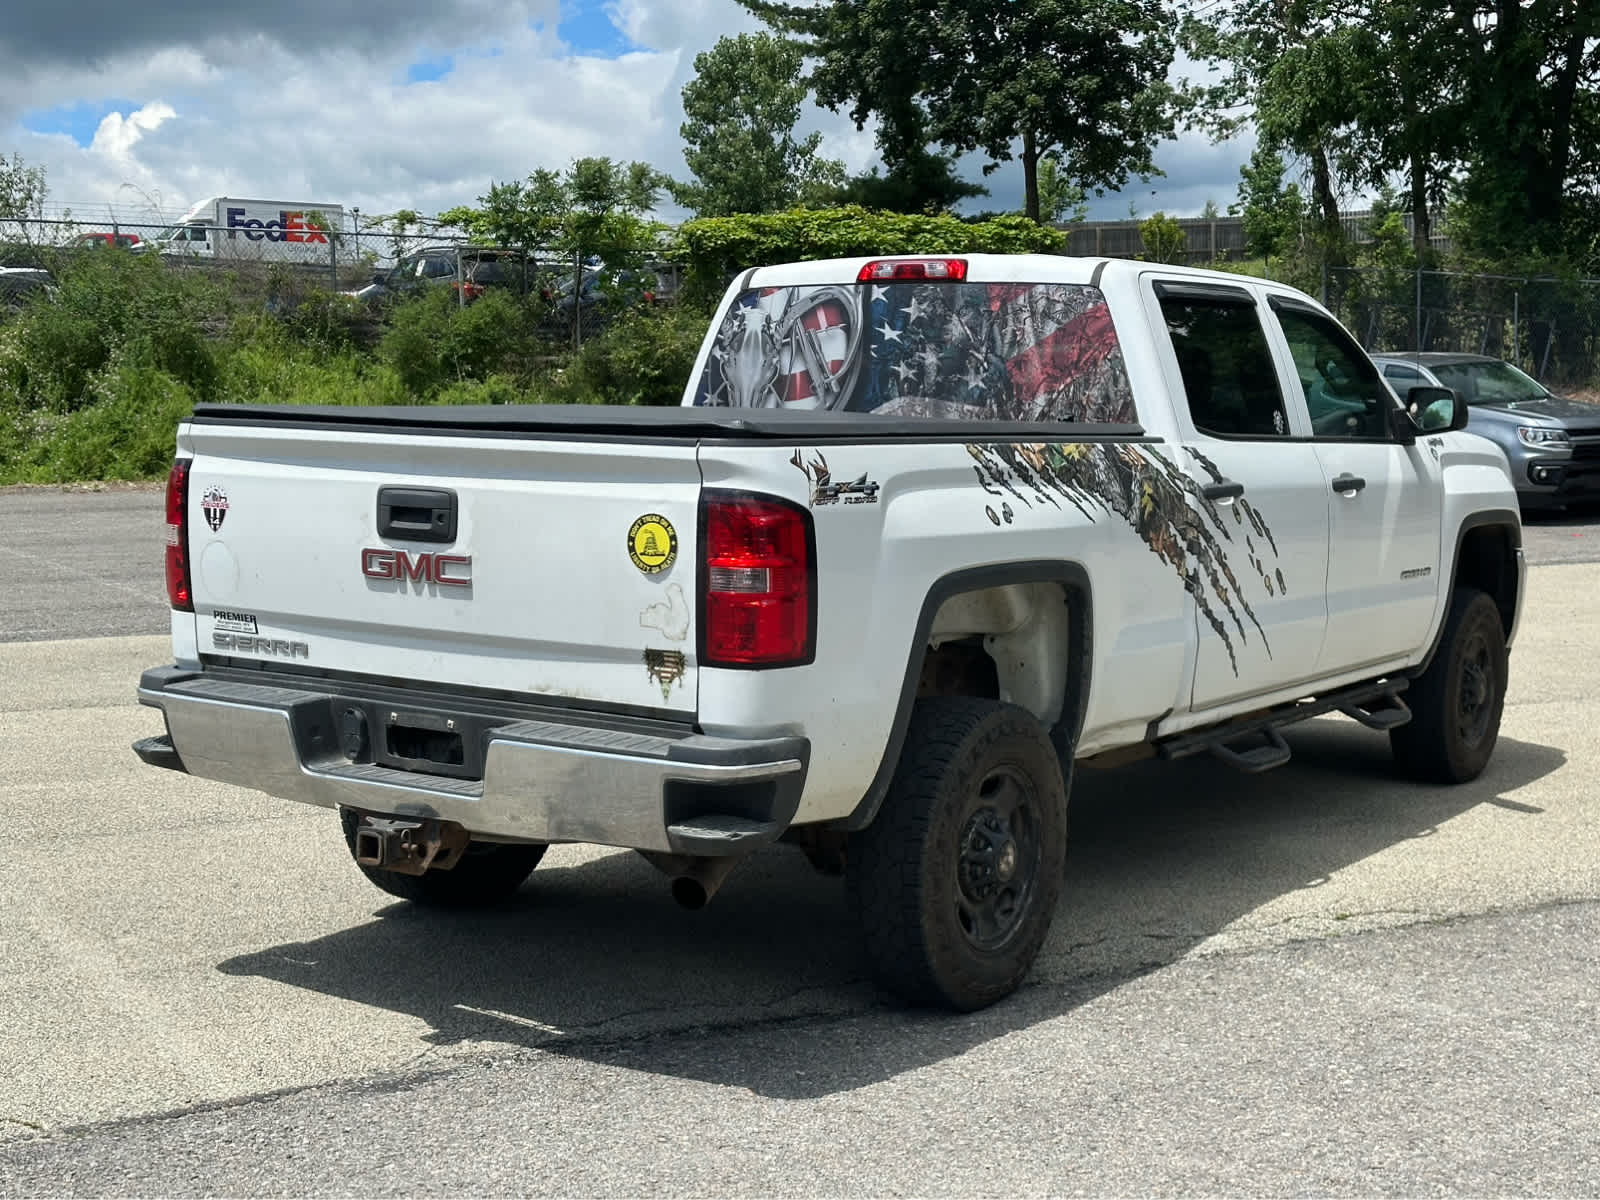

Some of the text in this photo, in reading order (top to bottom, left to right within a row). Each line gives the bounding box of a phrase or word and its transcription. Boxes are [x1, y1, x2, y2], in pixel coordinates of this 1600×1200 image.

[226, 207, 329, 243] FedEx
[361, 547, 472, 586] GMC
[213, 610, 257, 623] PREMIER
[212, 632, 309, 659] SIERRA
